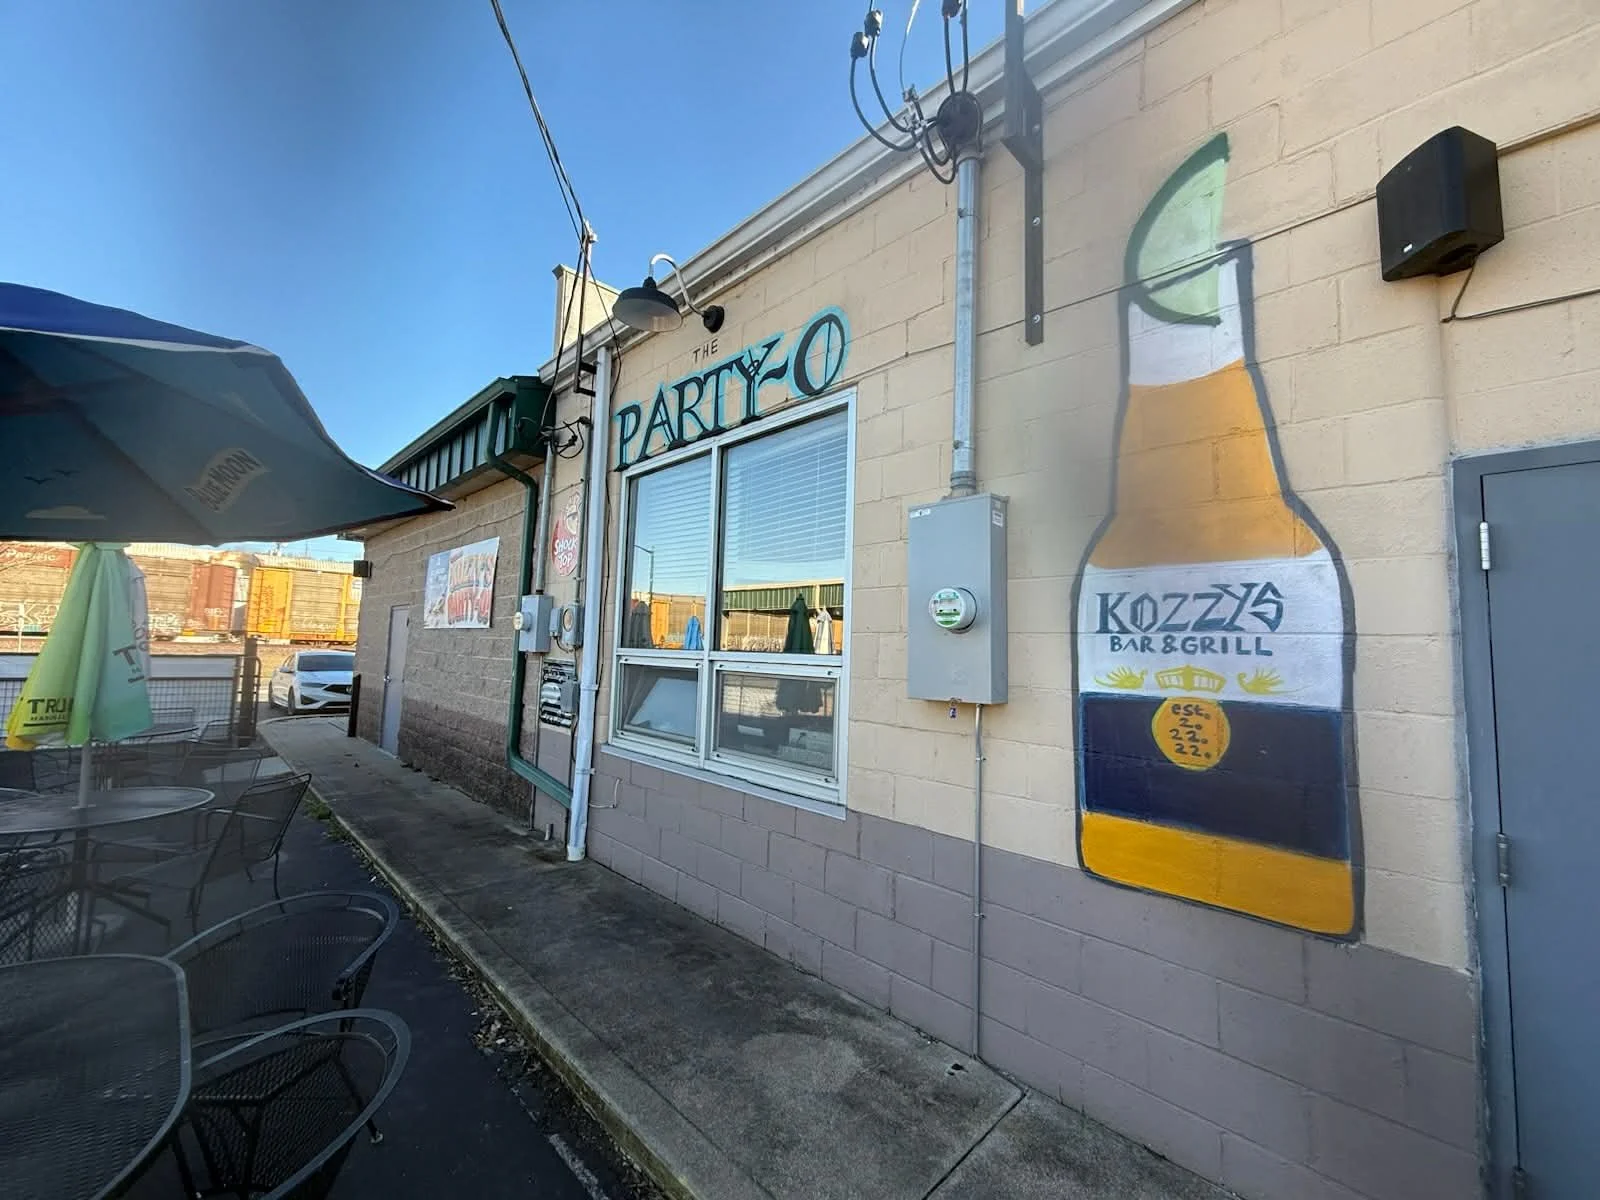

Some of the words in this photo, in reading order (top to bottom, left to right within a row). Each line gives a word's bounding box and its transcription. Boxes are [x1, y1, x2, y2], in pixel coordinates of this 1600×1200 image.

[693, 338, 719, 363] THE
[613, 312, 846, 473] PARTY-O
[558, 552, 573, 569] TOP
[1095, 581, 1285, 635] KOZZYS
[1110, 635, 1155, 654] BAR
